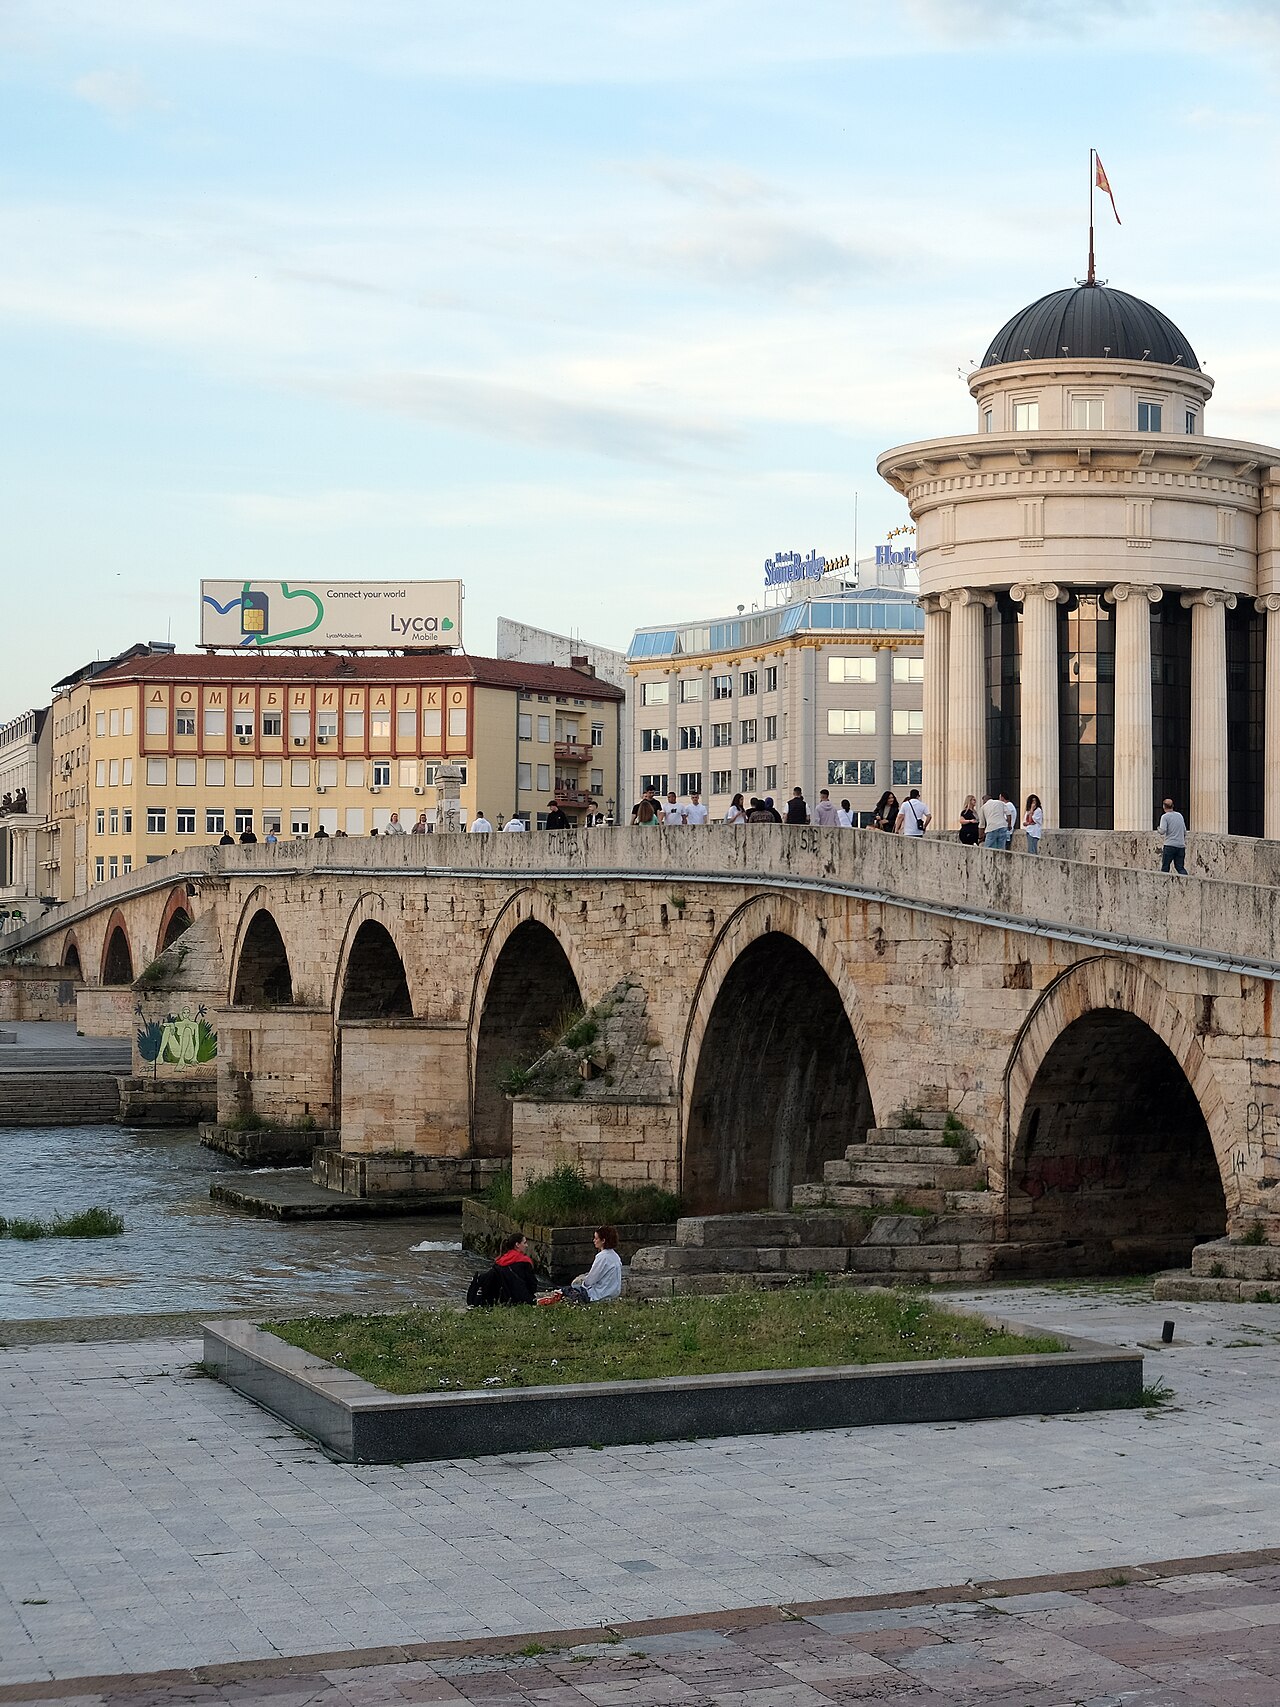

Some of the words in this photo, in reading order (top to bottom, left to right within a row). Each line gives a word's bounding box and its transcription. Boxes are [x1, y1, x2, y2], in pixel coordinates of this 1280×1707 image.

[326, 589, 362, 599] Connect
[363, 590, 382, 600] your
[382, 589, 406, 599] world
[390, 613, 438, 636] Lyca
[326, 632, 363, 640] LycaMobile.mk
[411, 632, 438, 642] Mobile
